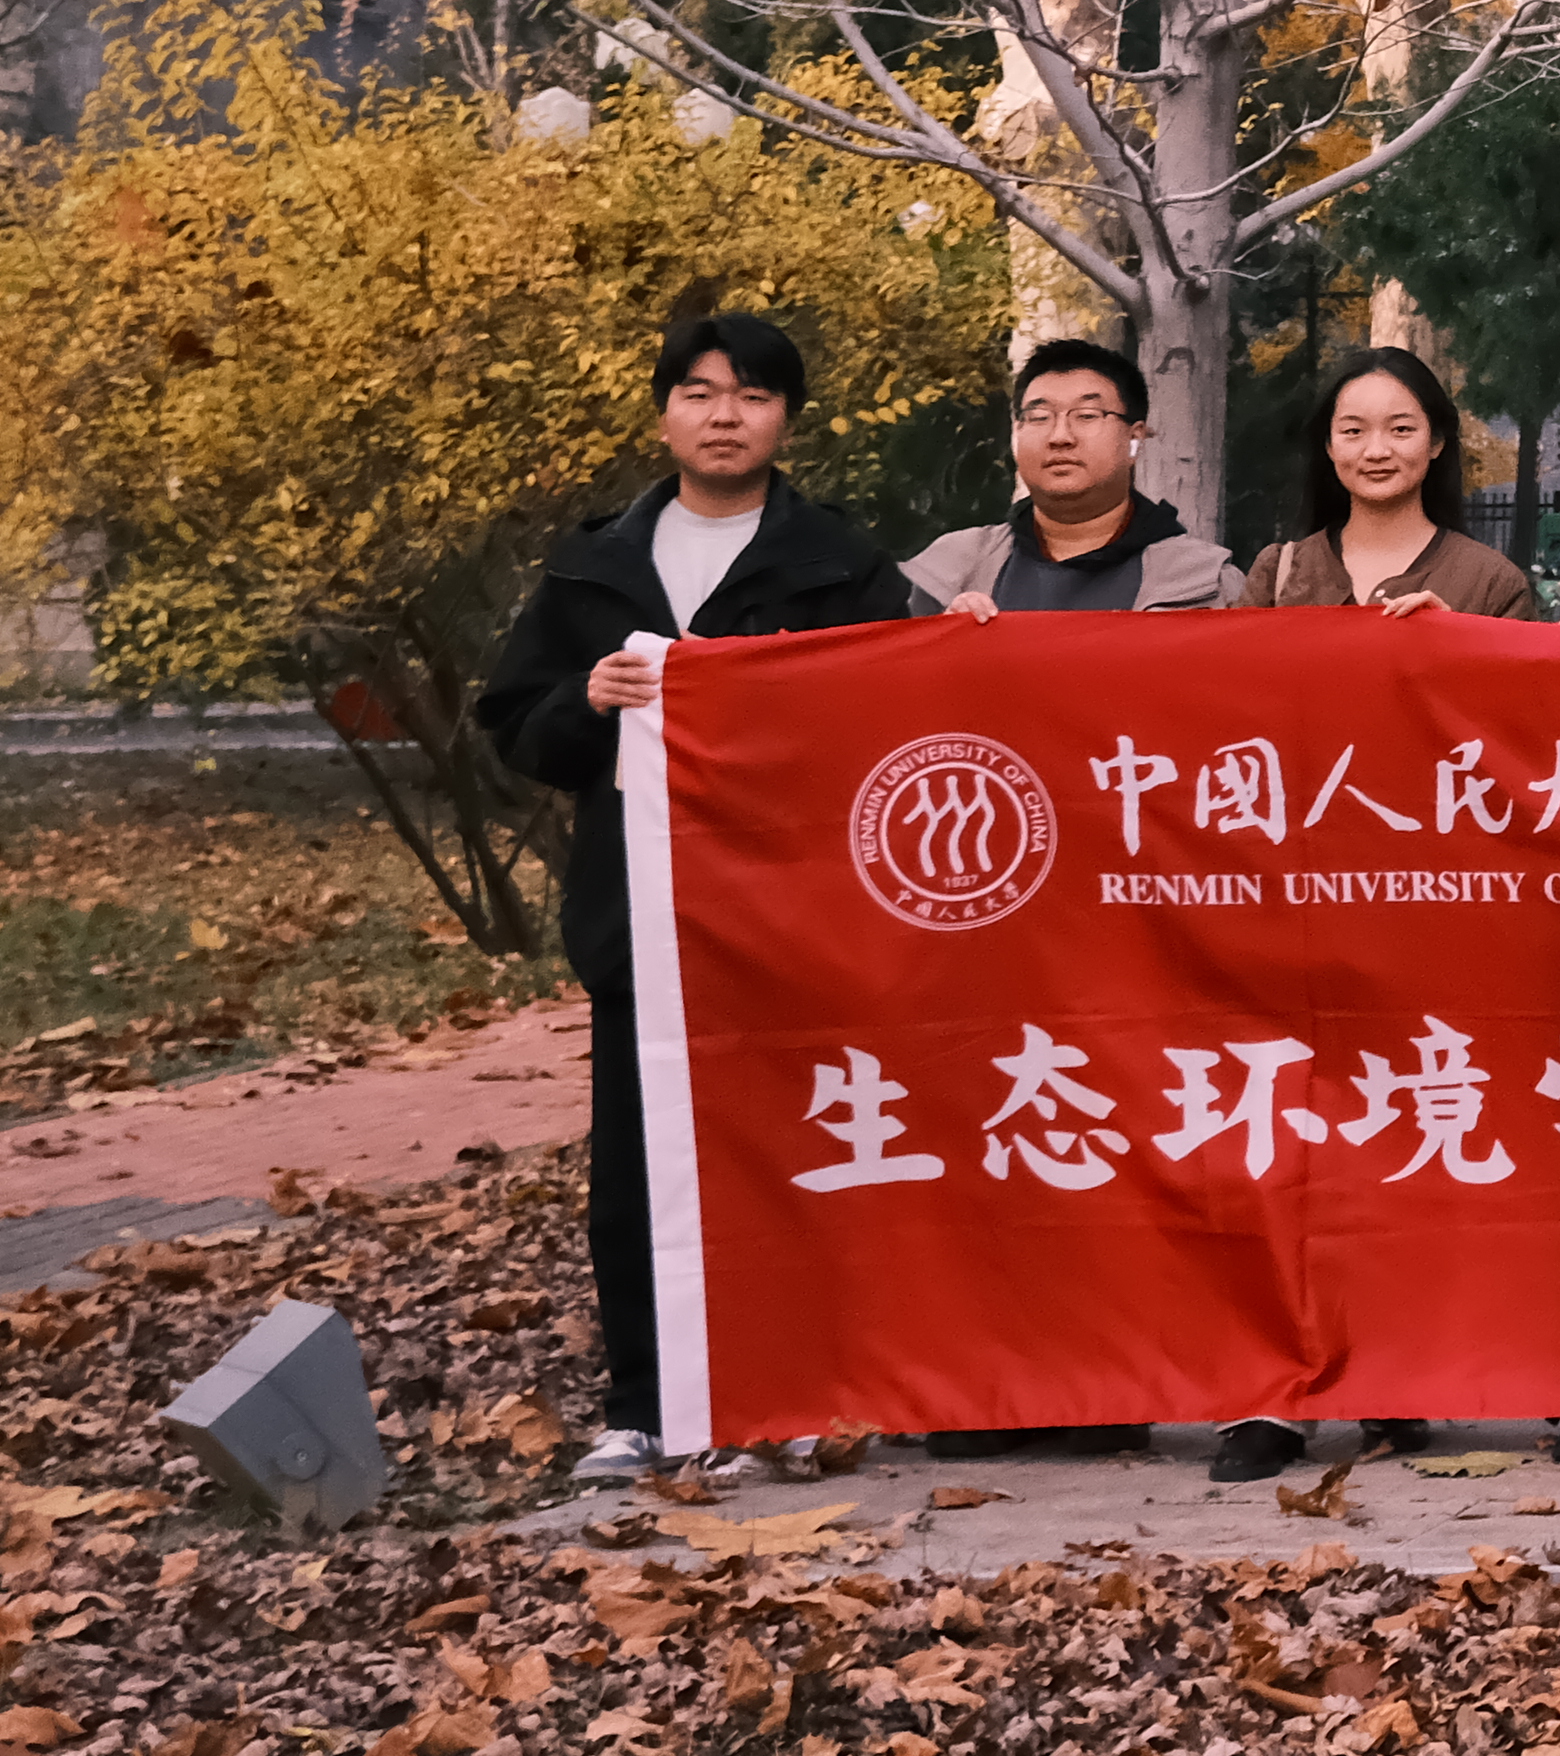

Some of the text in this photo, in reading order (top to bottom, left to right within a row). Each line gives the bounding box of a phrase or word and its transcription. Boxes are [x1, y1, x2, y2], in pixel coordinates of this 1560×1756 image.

[859, 743, 1049, 865] RENMIN UNIVERSITY OF CHINA
[1100, 872, 1262, 906] RENMIN
[1284, 871, 1525, 906] UNIVERSITY
